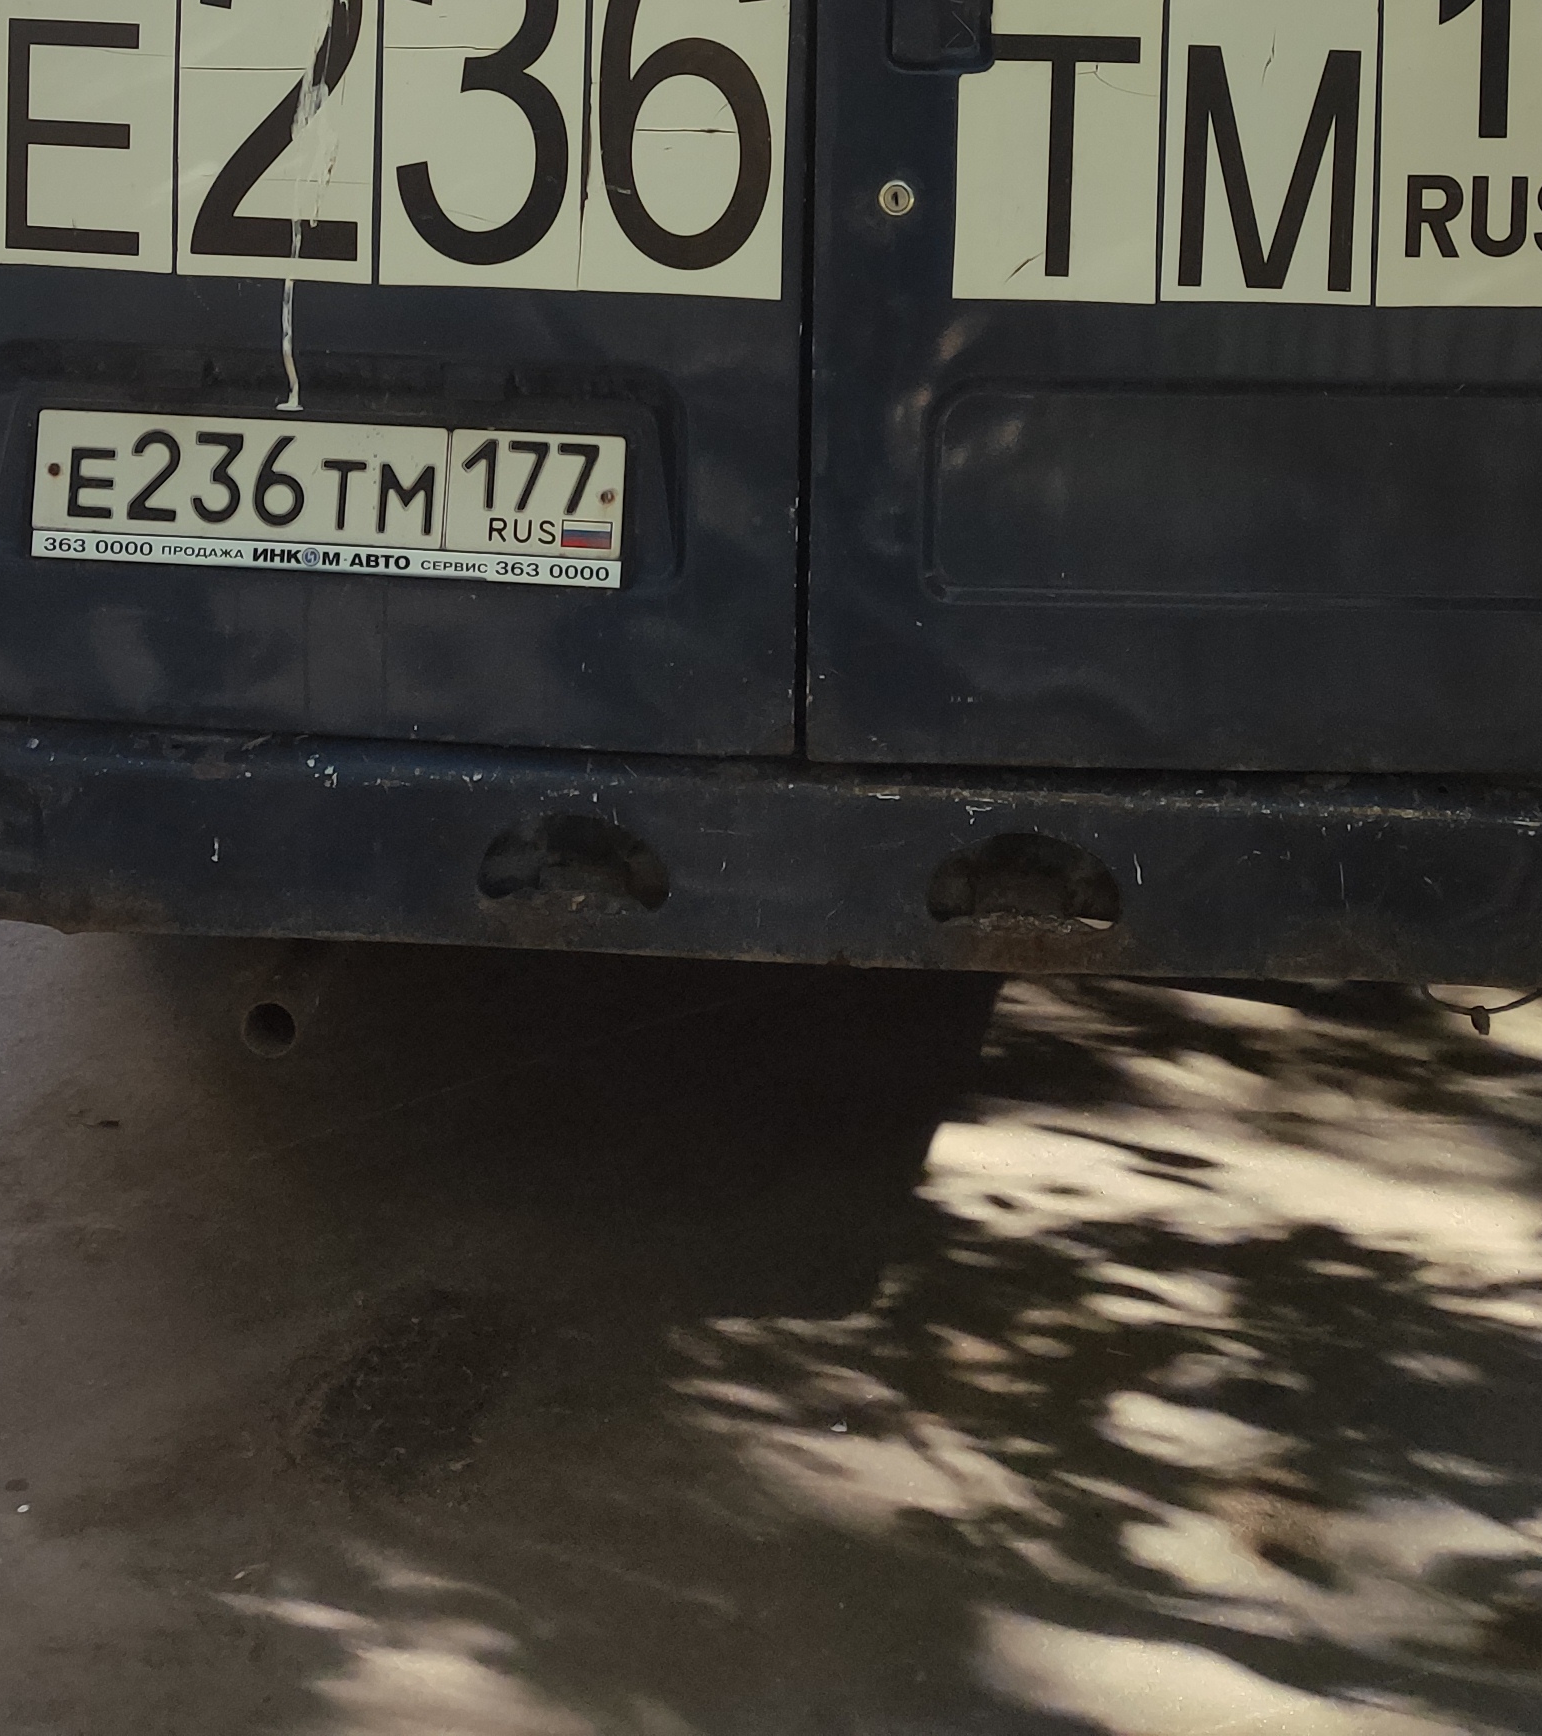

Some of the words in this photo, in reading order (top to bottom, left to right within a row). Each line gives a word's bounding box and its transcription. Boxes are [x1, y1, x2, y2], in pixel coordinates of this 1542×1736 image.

[462, 438, 600, 515] 177
[488, 517, 556, 545] RUS
[44, 537, 86, 553] 363
[95, 539, 153, 556] 0000
[161, 545, 245, 560] ПРОДАЖА
[420, 559, 489, 574] СЕРВИС
[495, 561, 540, 578] 363
[549, 563, 610, 581] 0000
